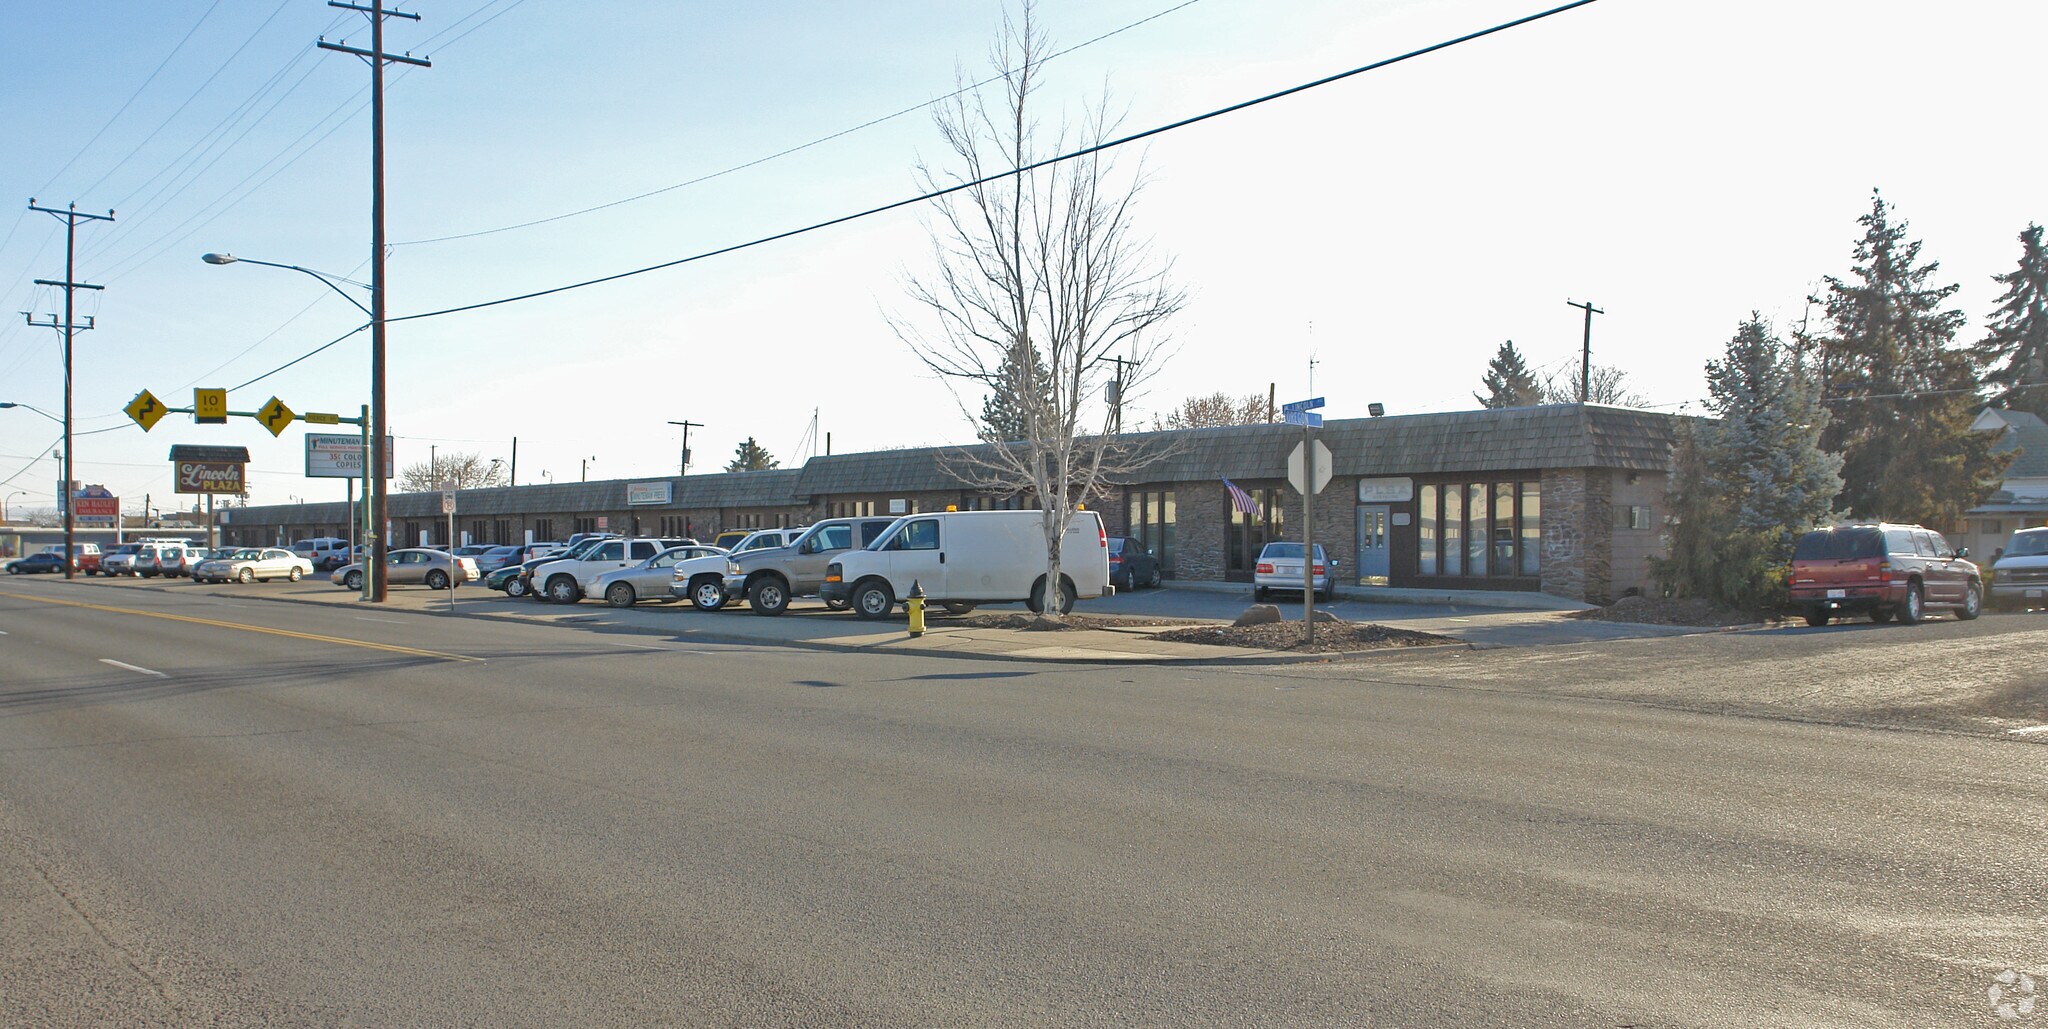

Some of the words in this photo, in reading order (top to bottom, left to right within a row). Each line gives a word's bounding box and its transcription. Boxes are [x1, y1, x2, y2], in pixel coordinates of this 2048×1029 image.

[203, 395, 218, 406] 10
[319, 437, 361, 445] MINUTEMAN
[343, 453, 362, 461] COLO
[181, 463, 239, 487] Lincoln
[203, 480, 240, 490] PLAZA
